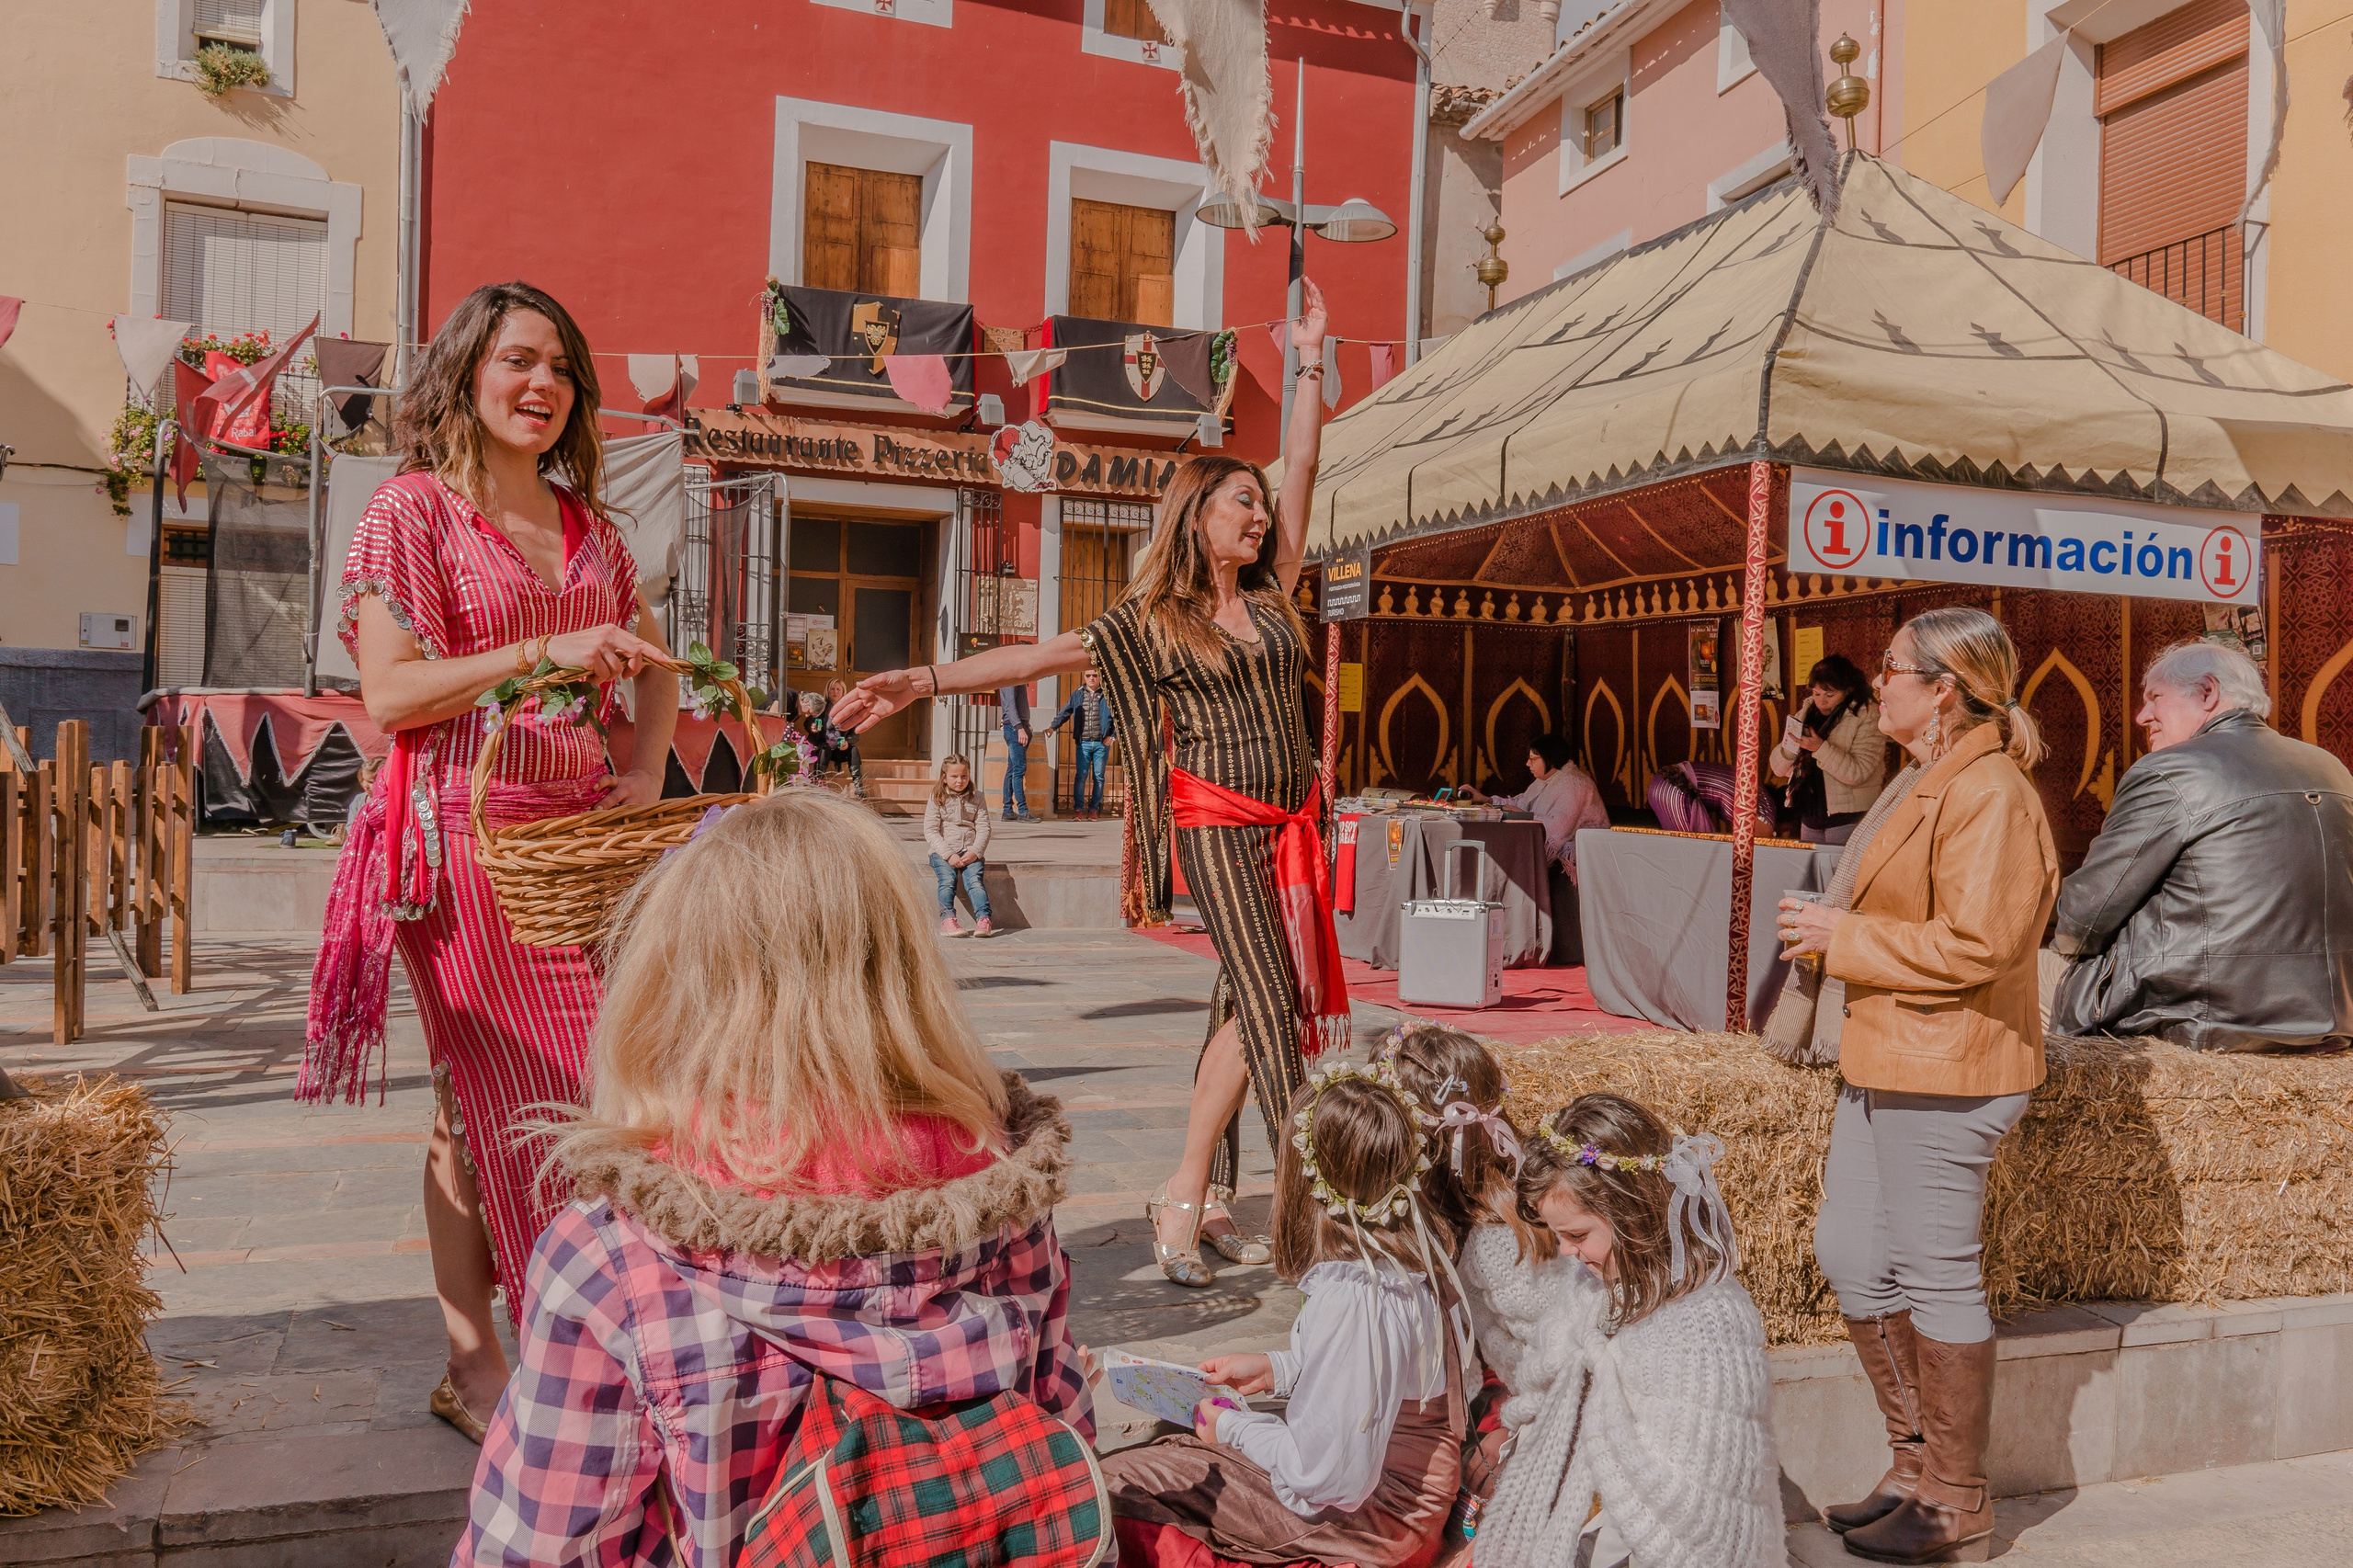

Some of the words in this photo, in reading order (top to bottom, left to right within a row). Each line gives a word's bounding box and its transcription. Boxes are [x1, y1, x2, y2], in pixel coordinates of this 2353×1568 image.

[231, 427, 256, 441] Rabal
[683, 415, 858, 460] Restaurante
[872, 434, 990, 473] Pizzeria
[1877, 508, 2194, 581] información
[1328, 562, 1361, 582] VILLENA
[1327, 608, 1345, 617] TURISMO
